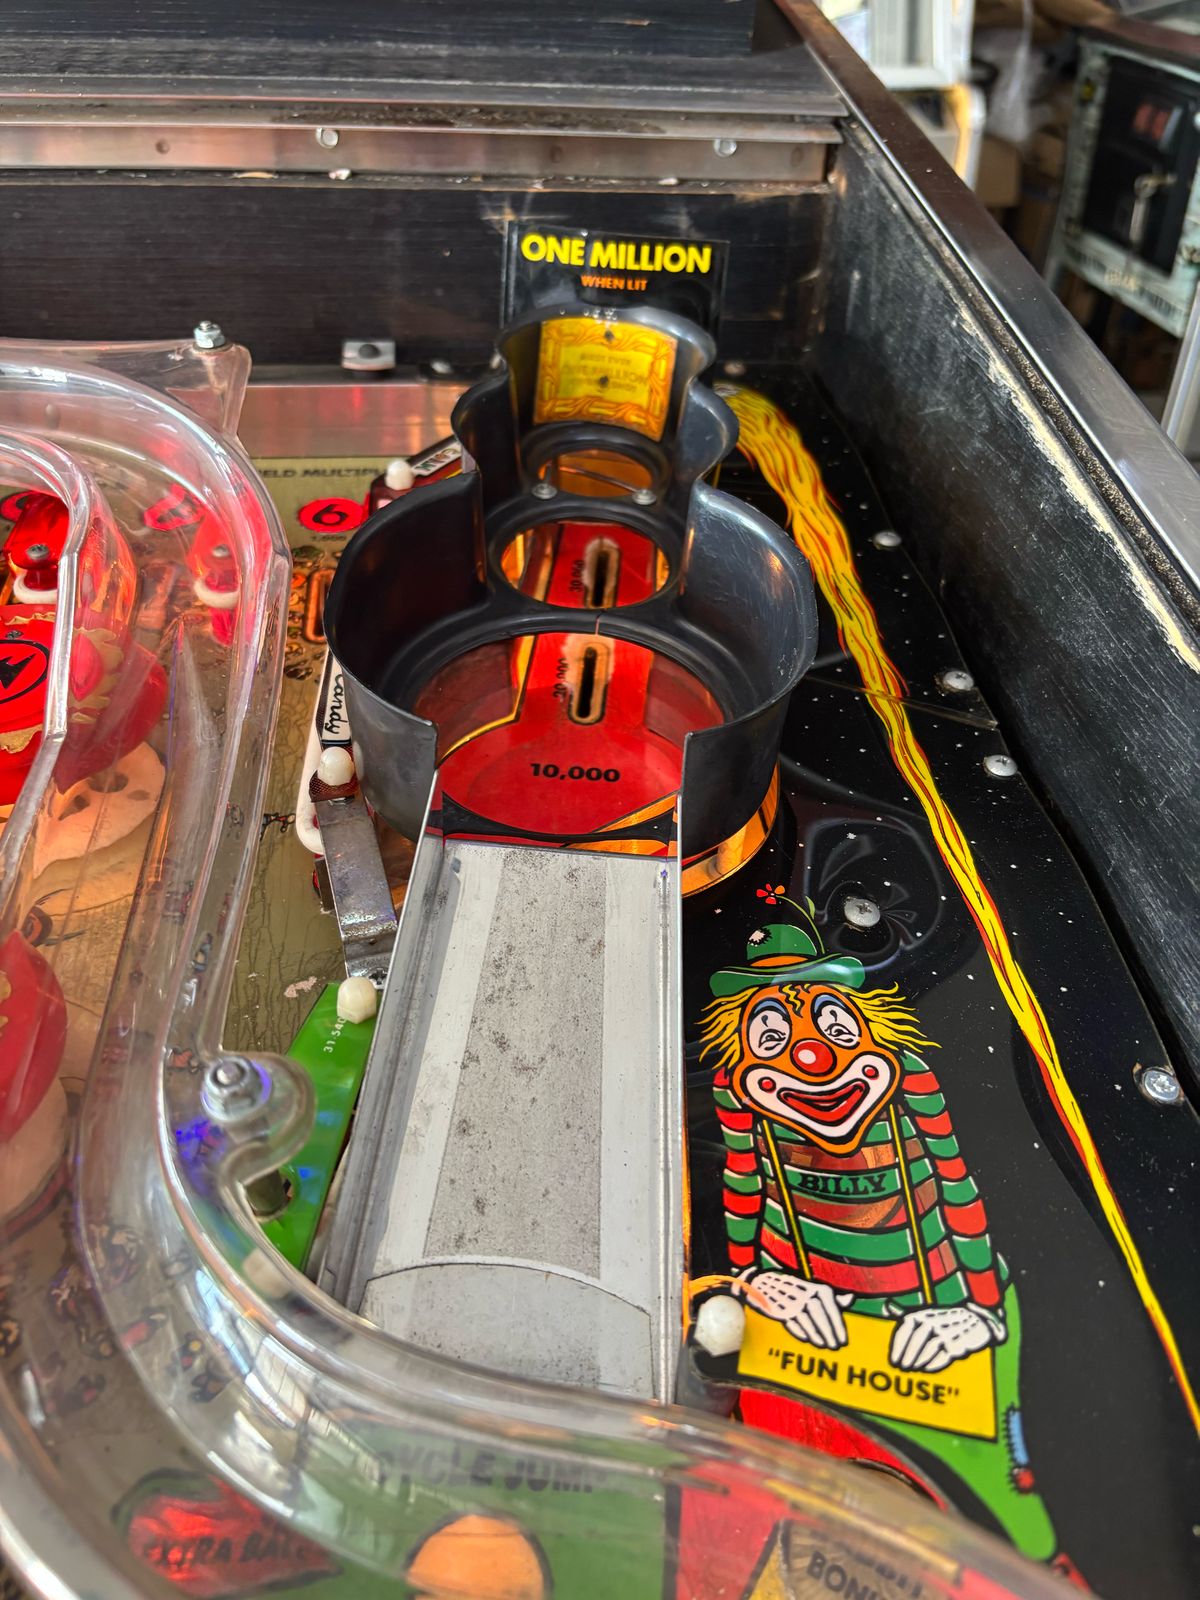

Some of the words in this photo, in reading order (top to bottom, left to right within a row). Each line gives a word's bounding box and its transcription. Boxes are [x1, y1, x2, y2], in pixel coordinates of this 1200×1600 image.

[521, 232, 586, 266] ONE
[589, 242, 712, 274] MILLION
[580, 274, 625, 290] WHEN
[627, 277, 648, 291] LIT
[312, 503, 349, 526] 6
[530, 763, 621, 783] 10,000
[799, 1173, 888, 1196] BILLY
